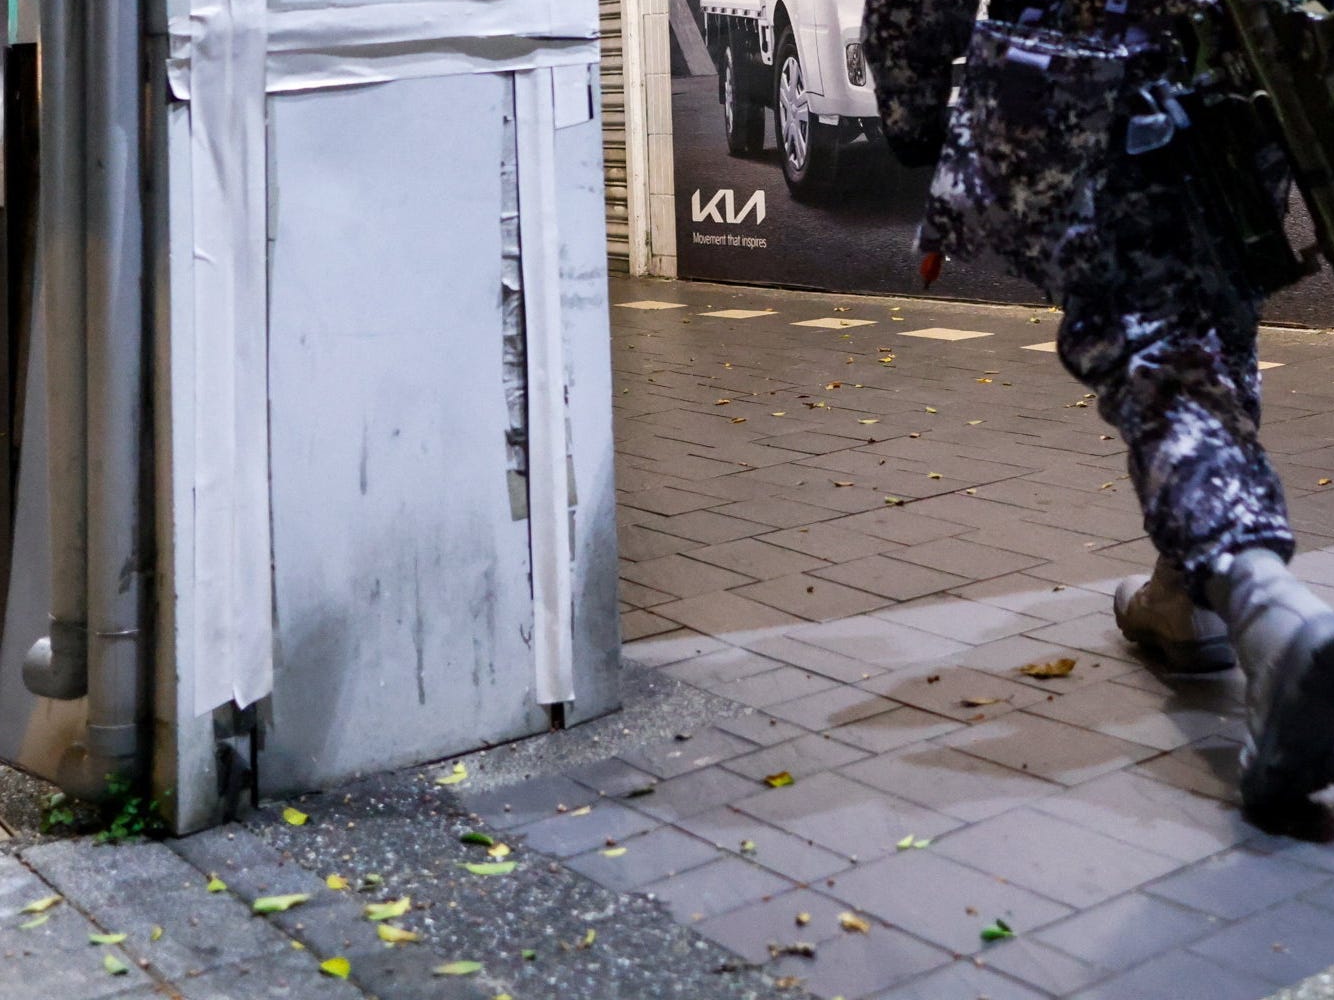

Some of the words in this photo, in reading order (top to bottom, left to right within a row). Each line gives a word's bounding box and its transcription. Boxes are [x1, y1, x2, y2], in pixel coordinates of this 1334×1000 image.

[691, 188, 767, 226] KIA
[692, 231, 727, 246] Movement
[728, 233, 741, 247] that
[742, 234, 768, 250] inspires
